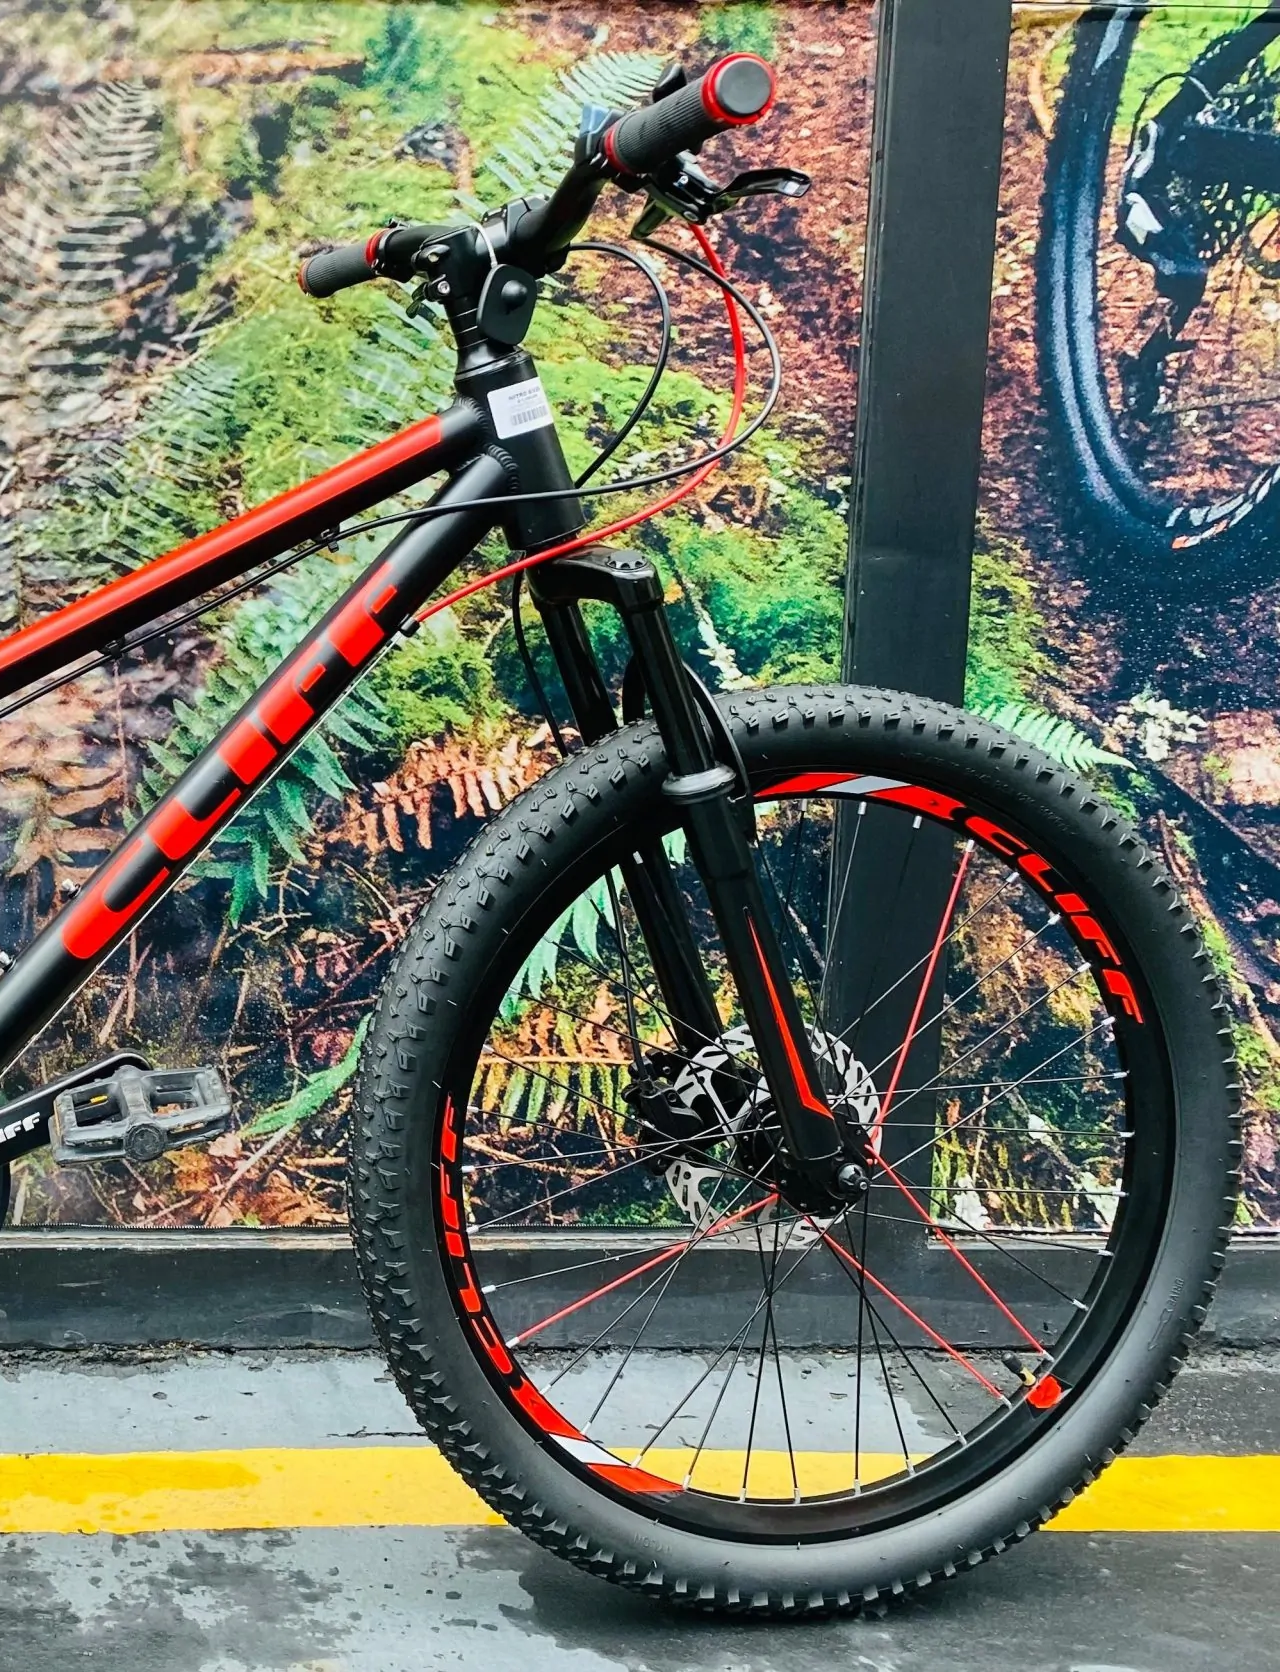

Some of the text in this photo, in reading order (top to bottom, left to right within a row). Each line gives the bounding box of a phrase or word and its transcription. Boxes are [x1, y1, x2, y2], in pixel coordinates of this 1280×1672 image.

[61, 561, 399, 960] CLIFF
[964, 815, 1144, 1024] CLIFF
[439, 1091, 514, 1375] CLIFF
